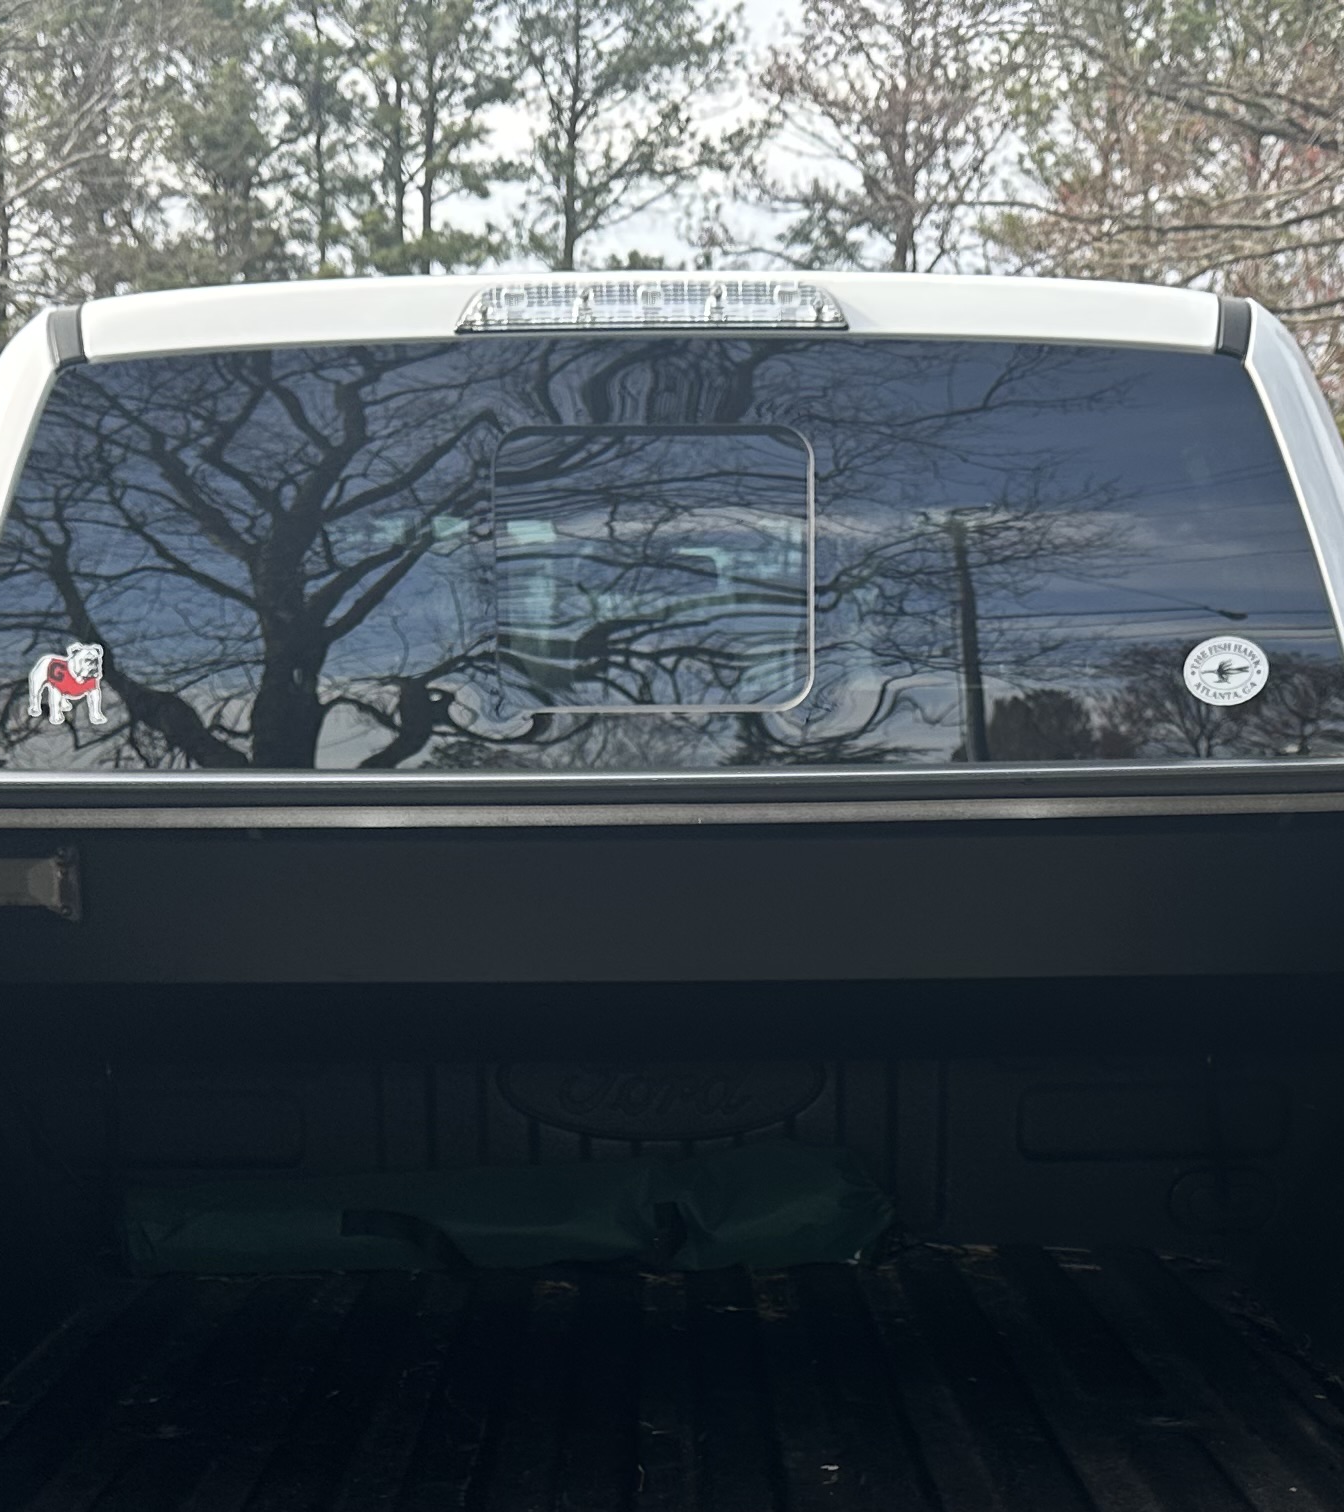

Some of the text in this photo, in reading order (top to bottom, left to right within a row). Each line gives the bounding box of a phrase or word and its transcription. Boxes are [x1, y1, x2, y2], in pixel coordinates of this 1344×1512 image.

[1191, 651, 1209, 669] THE
[1208, 643, 1232, 655] FISH
[51, 662, 65, 682] G
[1242, 682, 1257, 694] GA
